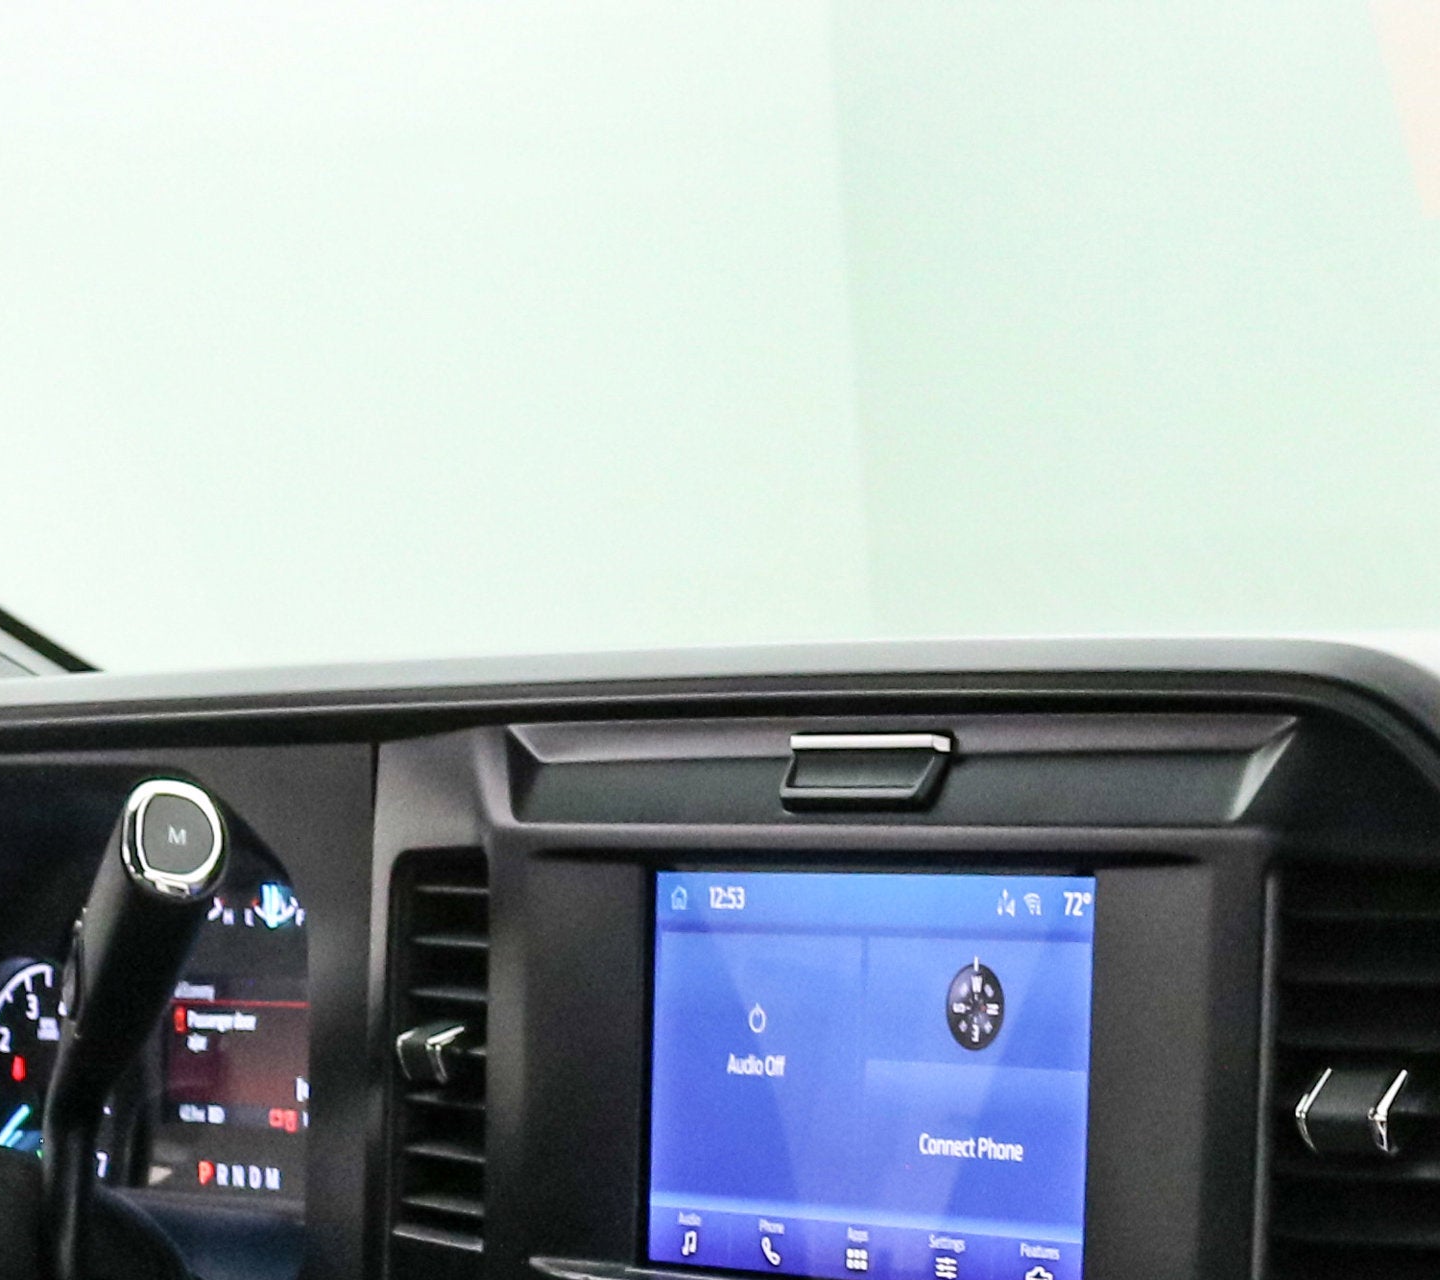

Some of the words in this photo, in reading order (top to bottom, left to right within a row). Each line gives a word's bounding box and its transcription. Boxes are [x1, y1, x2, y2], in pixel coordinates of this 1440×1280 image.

[167, 825, 187, 845] M
[709, 886, 745, 911] 12:53
[25, 993, 39, 1020] 3
[726, 1052, 764, 1076] Audio
[919, 1132, 976, 1158] Connect
[977, 1136, 1024, 1162] Phone
